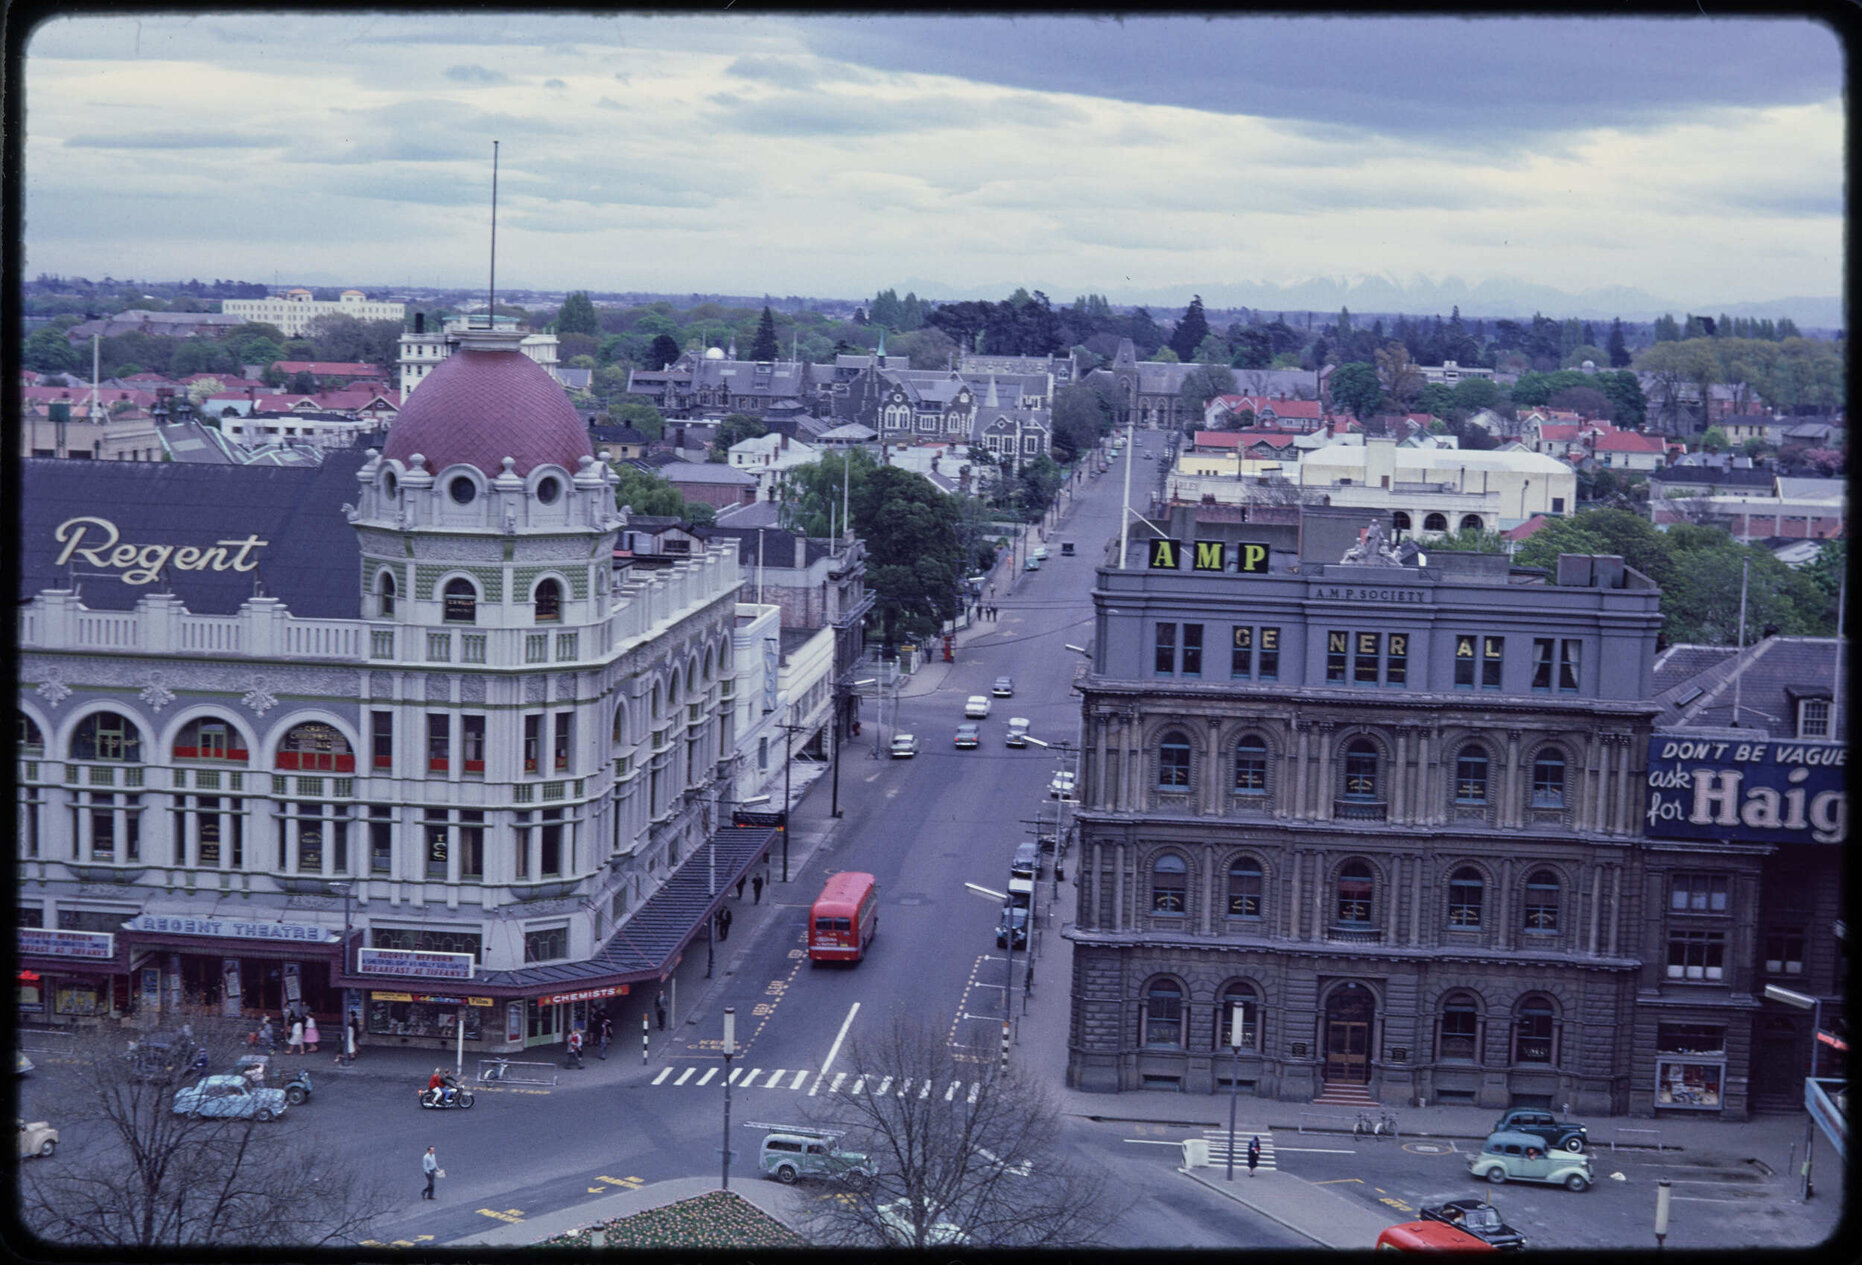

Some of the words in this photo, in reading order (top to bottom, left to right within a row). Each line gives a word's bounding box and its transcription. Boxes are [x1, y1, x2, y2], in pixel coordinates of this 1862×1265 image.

[55, 516, 269, 585] Regent
[1152, 541, 1266, 571] AMP
[1359, 590, 1425, 602] SOCIETY
[1661, 742, 1730, 760] DON'T
[1734, 744, 1767, 762] BE
[1775, 746, 1848, 765] VAGUE
[1648, 762, 1692, 789] ask
[1646, 792, 1685, 827] for
[1688, 767, 1848, 844] Haig
[143, 917, 222, 935] REGENT
[232, 922, 319, 940] THEATRE
[362, 965, 410, 975] BREAKFAST
[552, 987, 616, 1003] CHEMISTS
